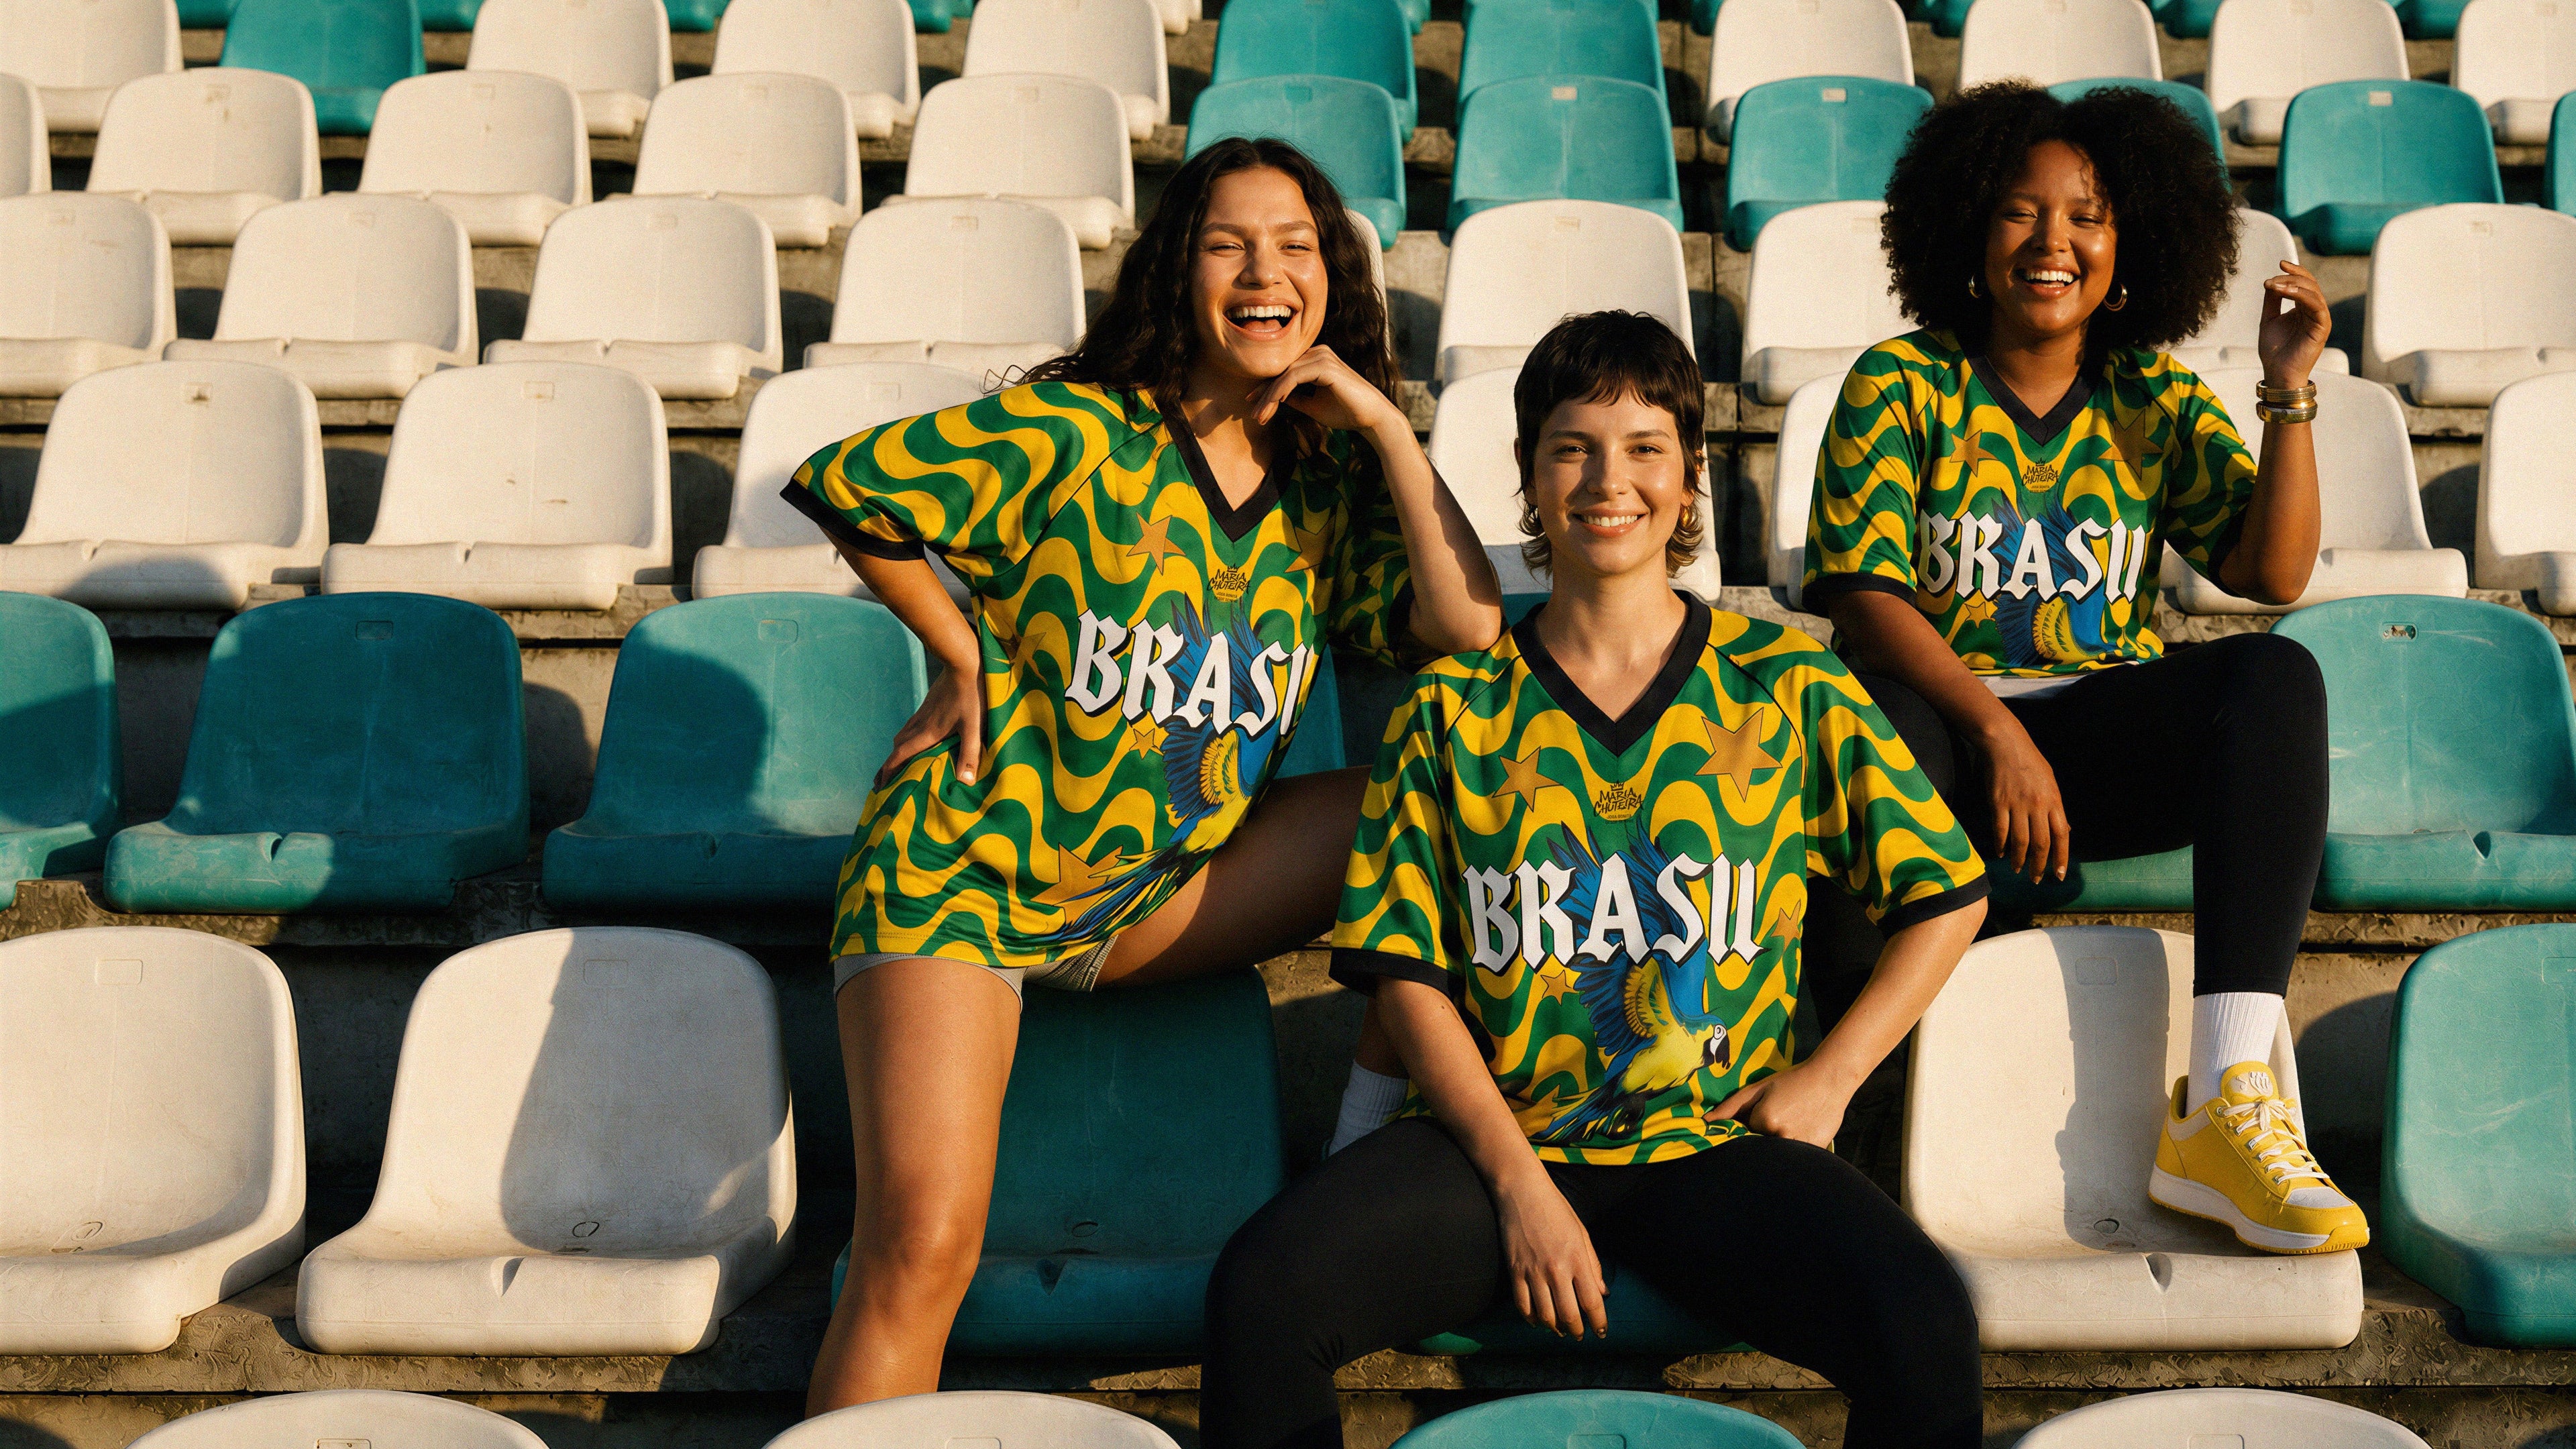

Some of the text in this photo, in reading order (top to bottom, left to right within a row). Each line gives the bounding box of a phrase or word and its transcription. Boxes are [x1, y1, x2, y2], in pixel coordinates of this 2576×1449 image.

[2022, 470, 2059, 486] CHUTEIRA
[2027, 464, 2055, 476] MARIA
[1215, 569, 1247, 582] MARIA
[1206, 578, 1251, 594] CHUTEIRA
[1065, 608, 1315, 741] BRASI
[1599, 788, 1638, 803] MARIA
[1593, 794, 1644, 817] CHUTEIRA
[1462, 851, 1771, 975] BRASIL
